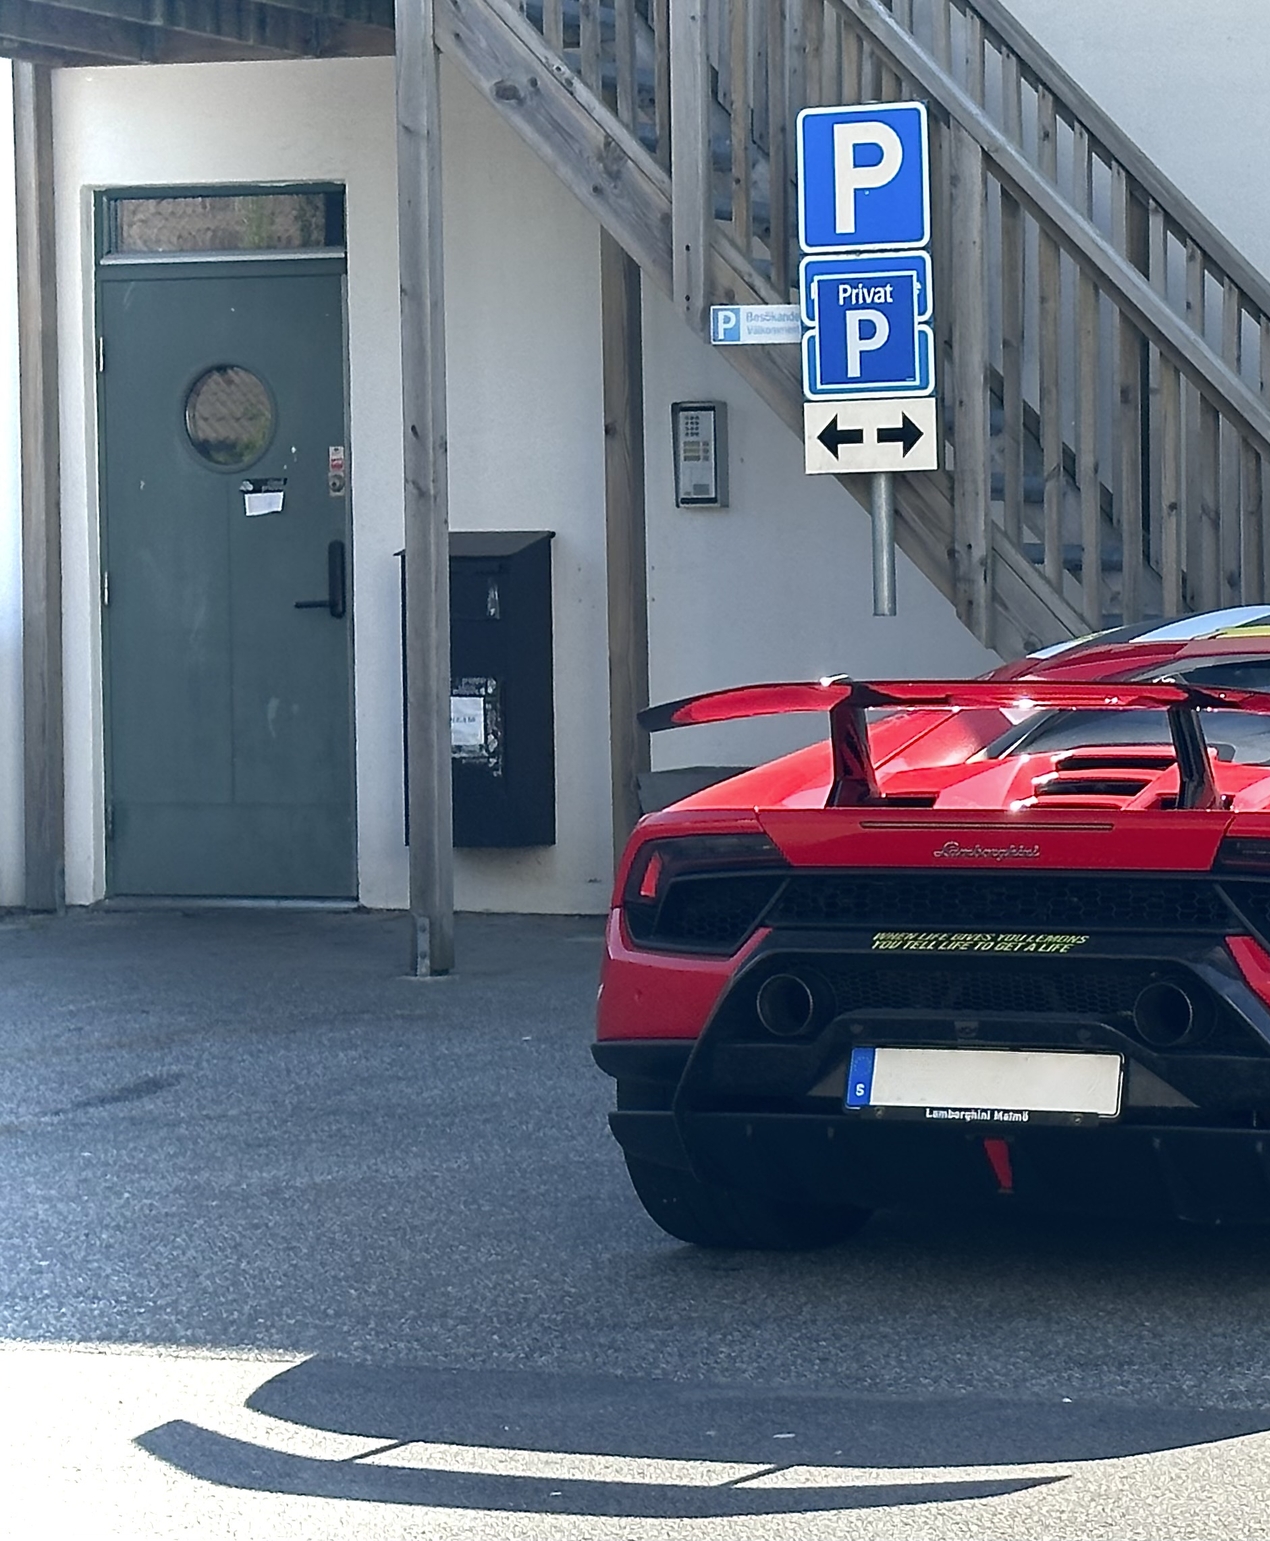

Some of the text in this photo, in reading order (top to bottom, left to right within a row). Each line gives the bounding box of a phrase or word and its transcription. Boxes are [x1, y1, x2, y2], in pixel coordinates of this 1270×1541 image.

[833, 121, 904, 234] P
[838, 282, 894, 305] Privat
[717, 310, 736, 340] P
[845, 308, 890, 378] P
[933, 840, 1040, 861] Lamborghini
[871, 940, 1075, 953] YOU TELL LIFE TO GET A LIFE
[872, 932, 1090, 944] WHEN LIFE GIVES YOU LEMONS
[855, 1083, 865, 1097] S
[925, 1108, 991, 1122] Lamborghini
